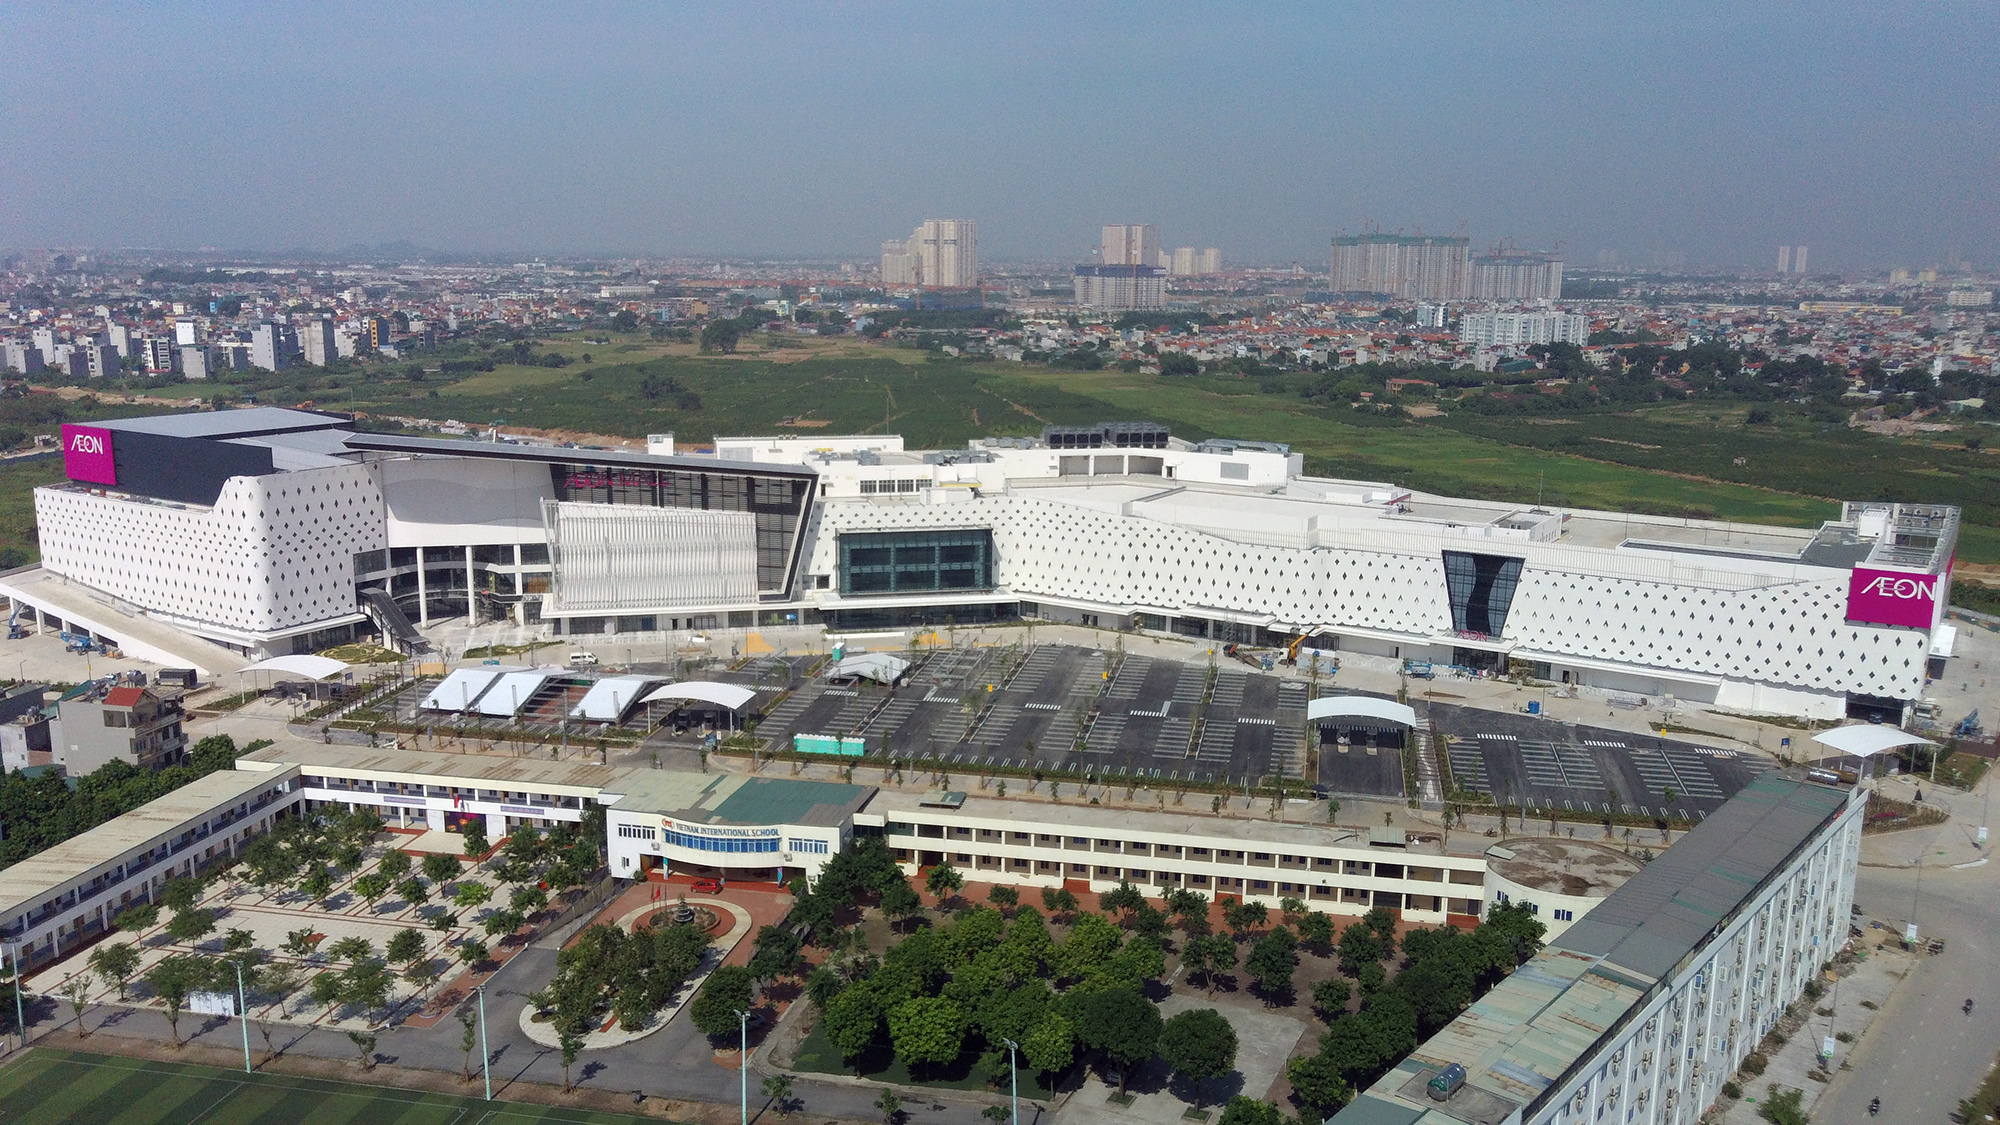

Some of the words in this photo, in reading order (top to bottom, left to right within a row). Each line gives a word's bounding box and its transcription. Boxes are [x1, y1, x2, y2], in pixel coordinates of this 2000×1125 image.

[676, 823, 699, 834] VIETNAM
[700, 826, 750, 837] INTERNATIONAL
[751, 828, 779, 837] SCHOOL
